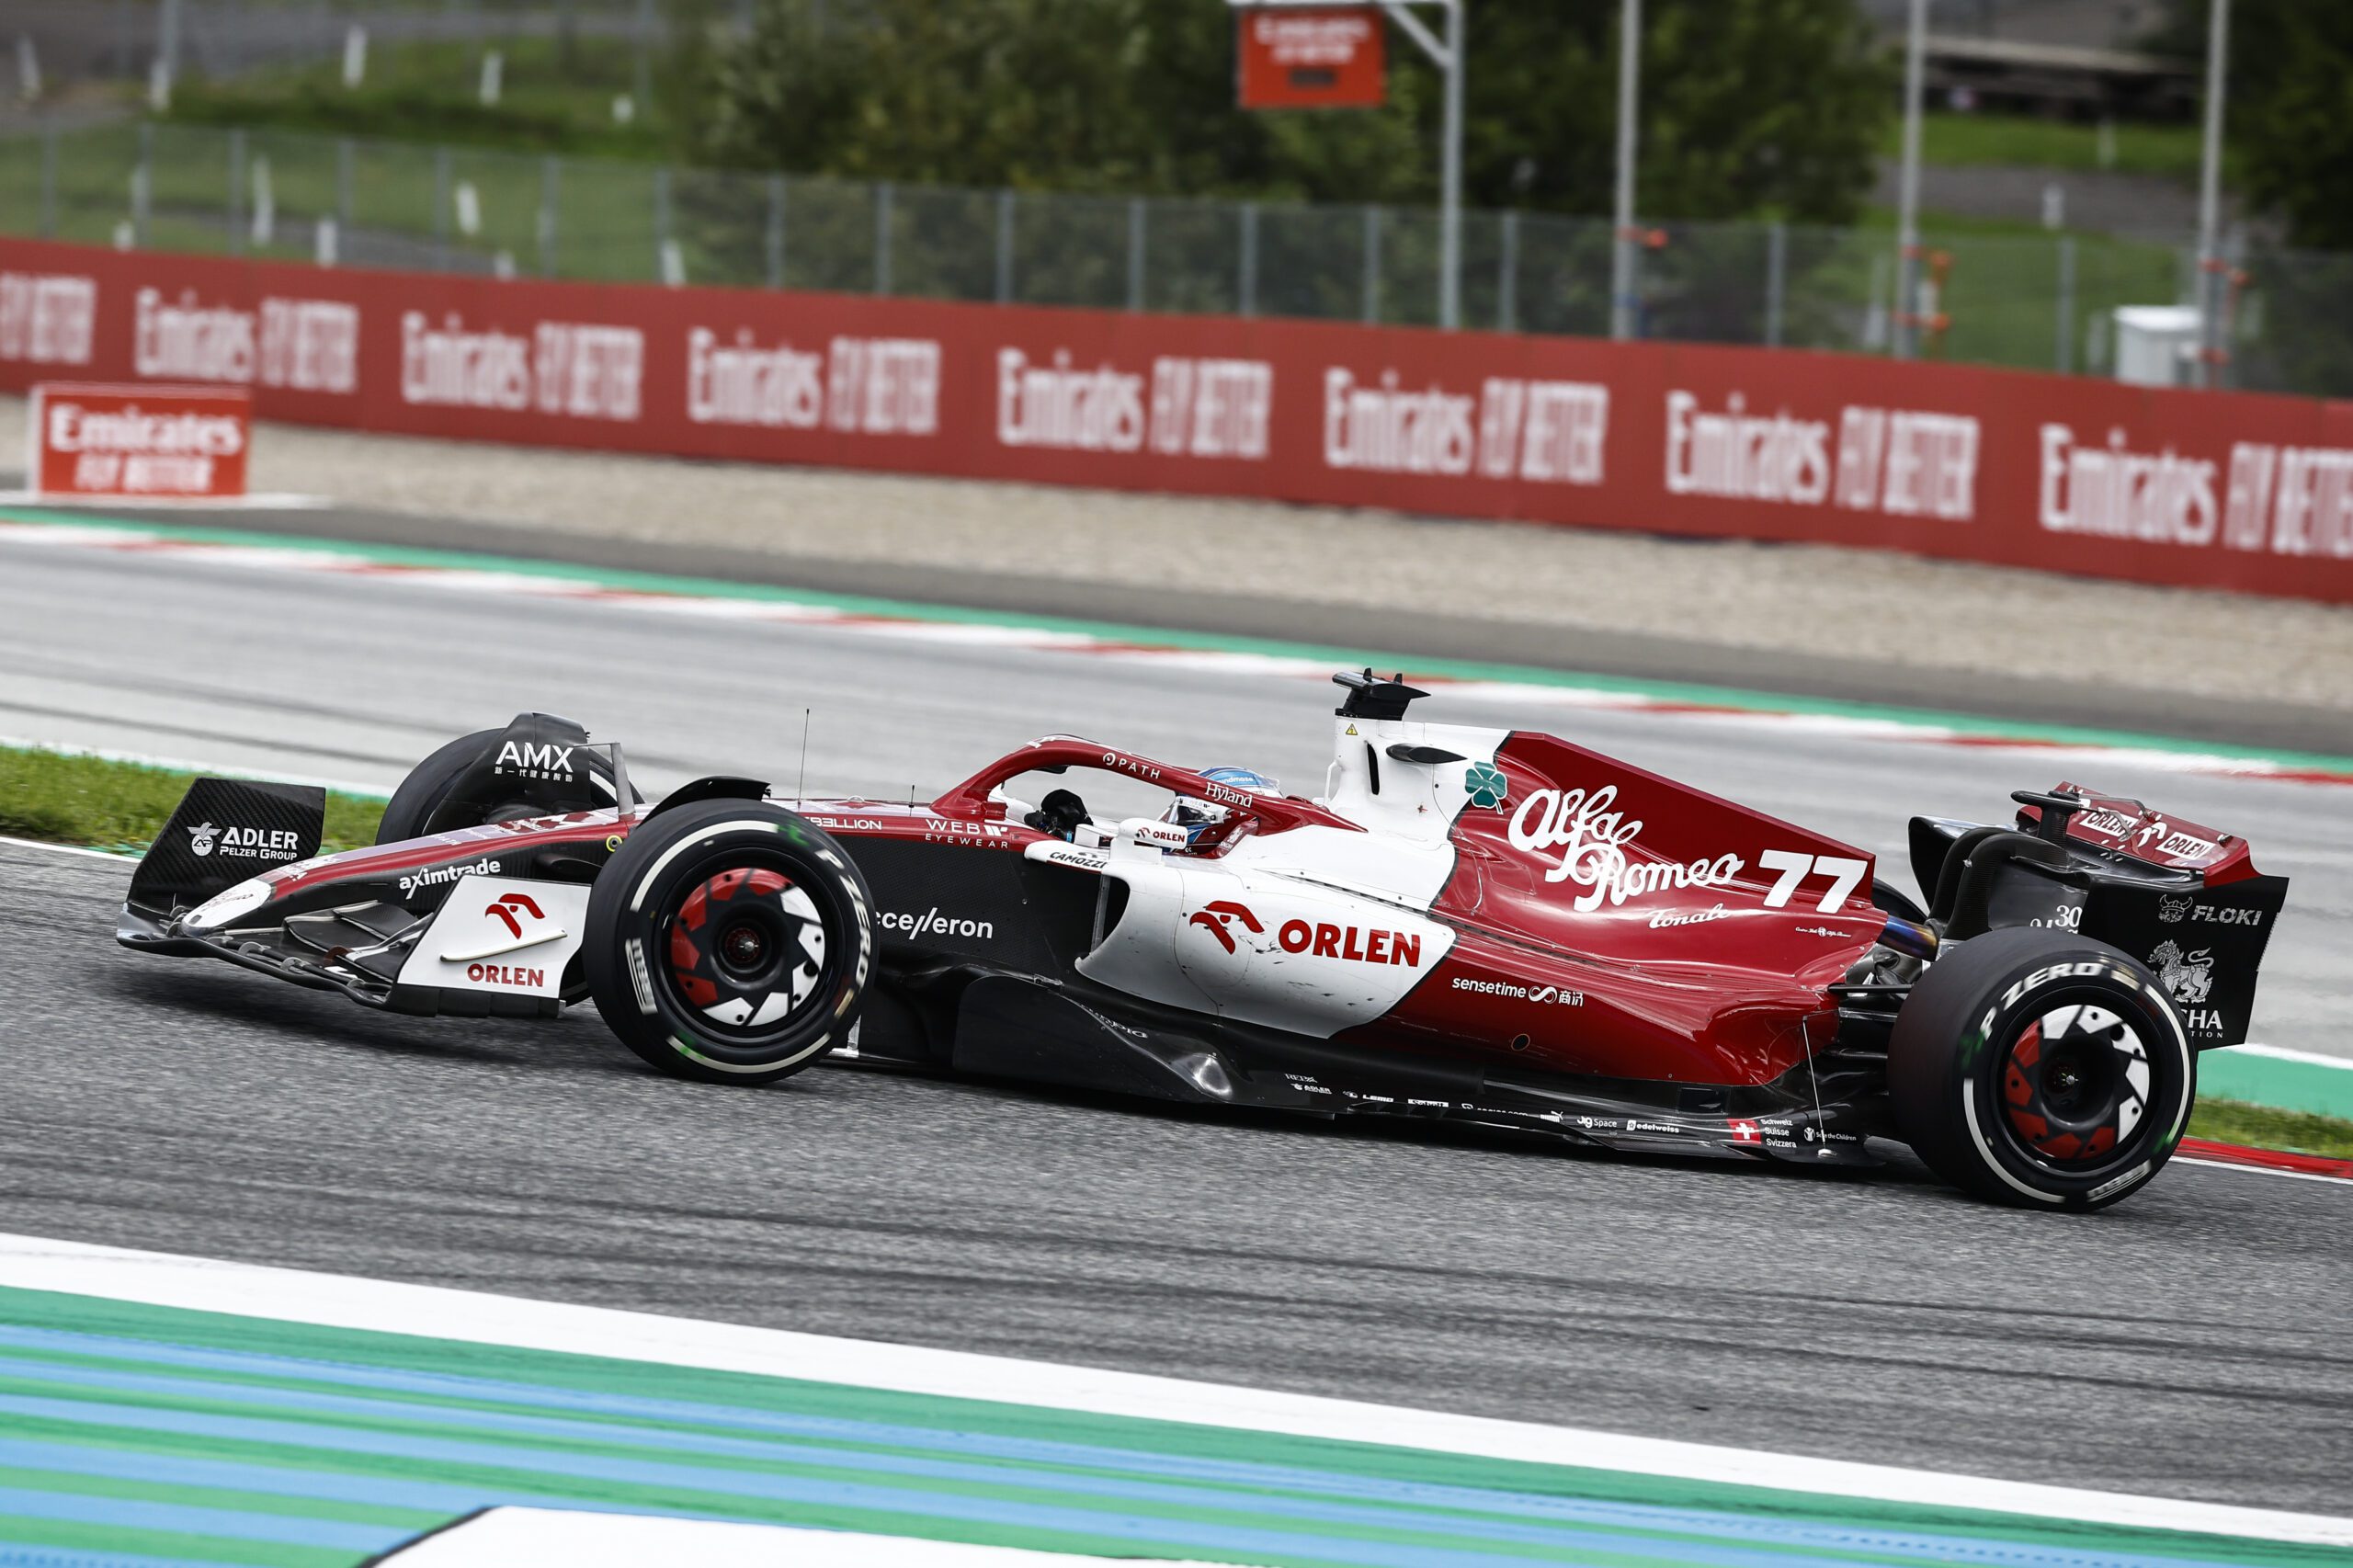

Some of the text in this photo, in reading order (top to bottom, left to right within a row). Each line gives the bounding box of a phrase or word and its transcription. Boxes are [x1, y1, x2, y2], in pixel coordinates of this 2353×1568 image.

[402, 310, 529, 411] Emirates
[688, 326, 822, 428] Emirates
[997, 347, 1145, 453] Emirates
[50, 403, 244, 455] Emirates
[1324, 367, 1472, 476] Emirates
[1665, 390, 1829, 504] Emirates
[2040, 424, 2218, 545] Emirates
[495, 741, 574, 773] AMX
[1205, 781, 1253, 809] Hyland
[806, 816, 882, 831] BELLION
[925, 818, 981, 835] WEB
[1507, 785, 1643, 882] Alfa
[221, 826, 299, 850] ADLER
[925, 833, 1009, 849] EYEWEAR
[1153, 831, 1186, 843] ORLEN
[2164, 835, 2210, 858] ORLEN
[219, 846, 298, 861] PELZER GROUP
[1050, 851, 1107, 869] CAMOZZI
[399, 858, 501, 900] aximtrade
[1549, 840, 1745, 913] Romeo
[1758, 848, 1869, 915] 77
[1648, 903, 1733, 929] Tonale
[2055, 904, 2083, 928] 30
[2191, 904, 2263, 926] FLOKI
[1278, 918, 1421, 968] ORLEN
[467, 962, 544, 988] ORLEN
[1452, 977, 1527, 998] sensetime
[2000, 962, 2103, 1010] ZERO
[1636, 1122, 1680, 1133] edelweiss
[1764, 1127, 1790, 1137] Suisse
[1766, 1138, 1797, 1148] Svizzera
